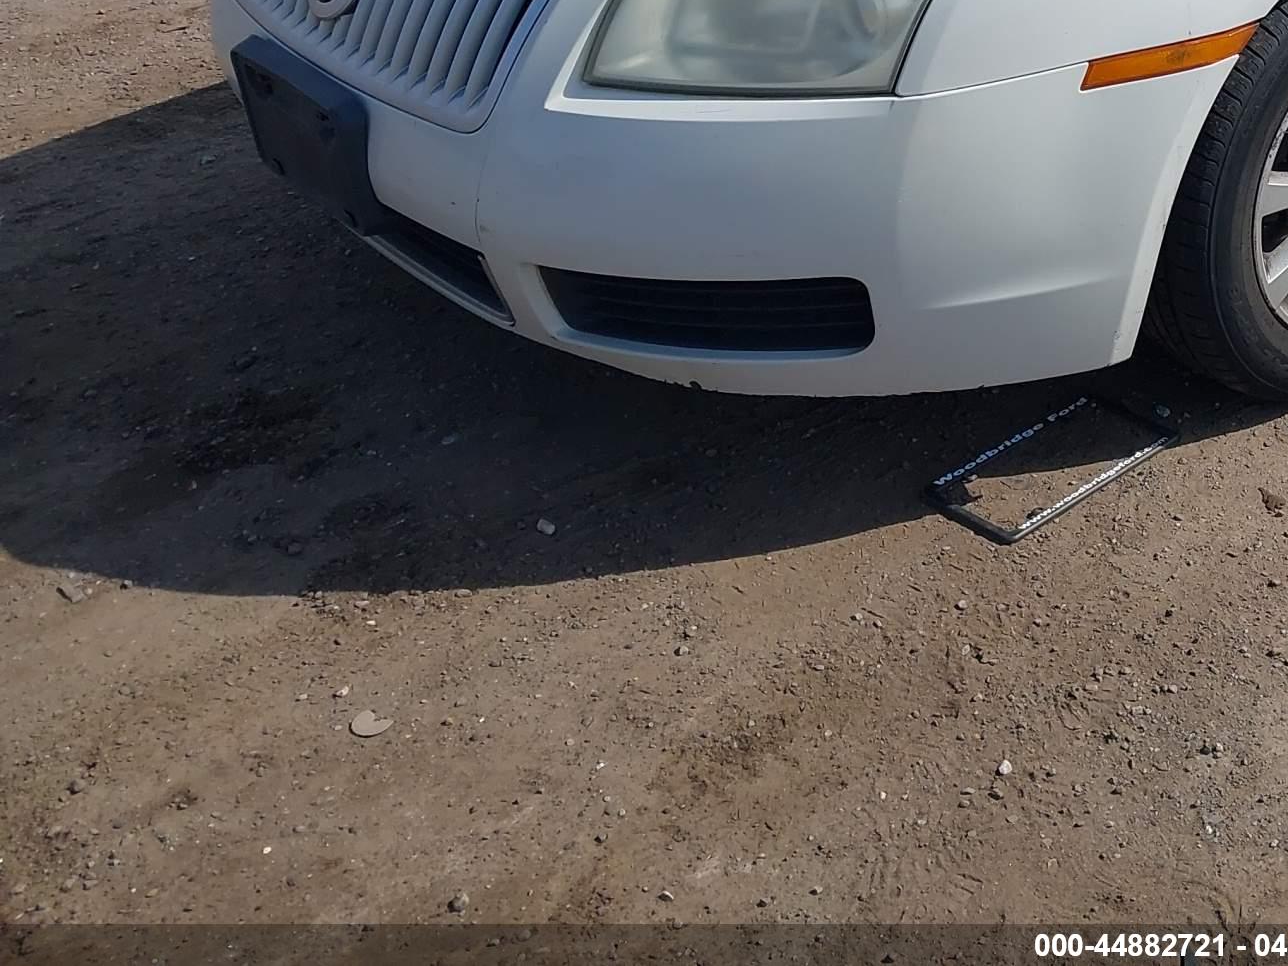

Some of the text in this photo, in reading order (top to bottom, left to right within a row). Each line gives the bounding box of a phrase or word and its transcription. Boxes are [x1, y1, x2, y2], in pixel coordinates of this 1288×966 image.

[933, 397, 1088, 485] Woodbridge Ford
[1018, 437, 1169, 529] www.woodbridgeford.com
